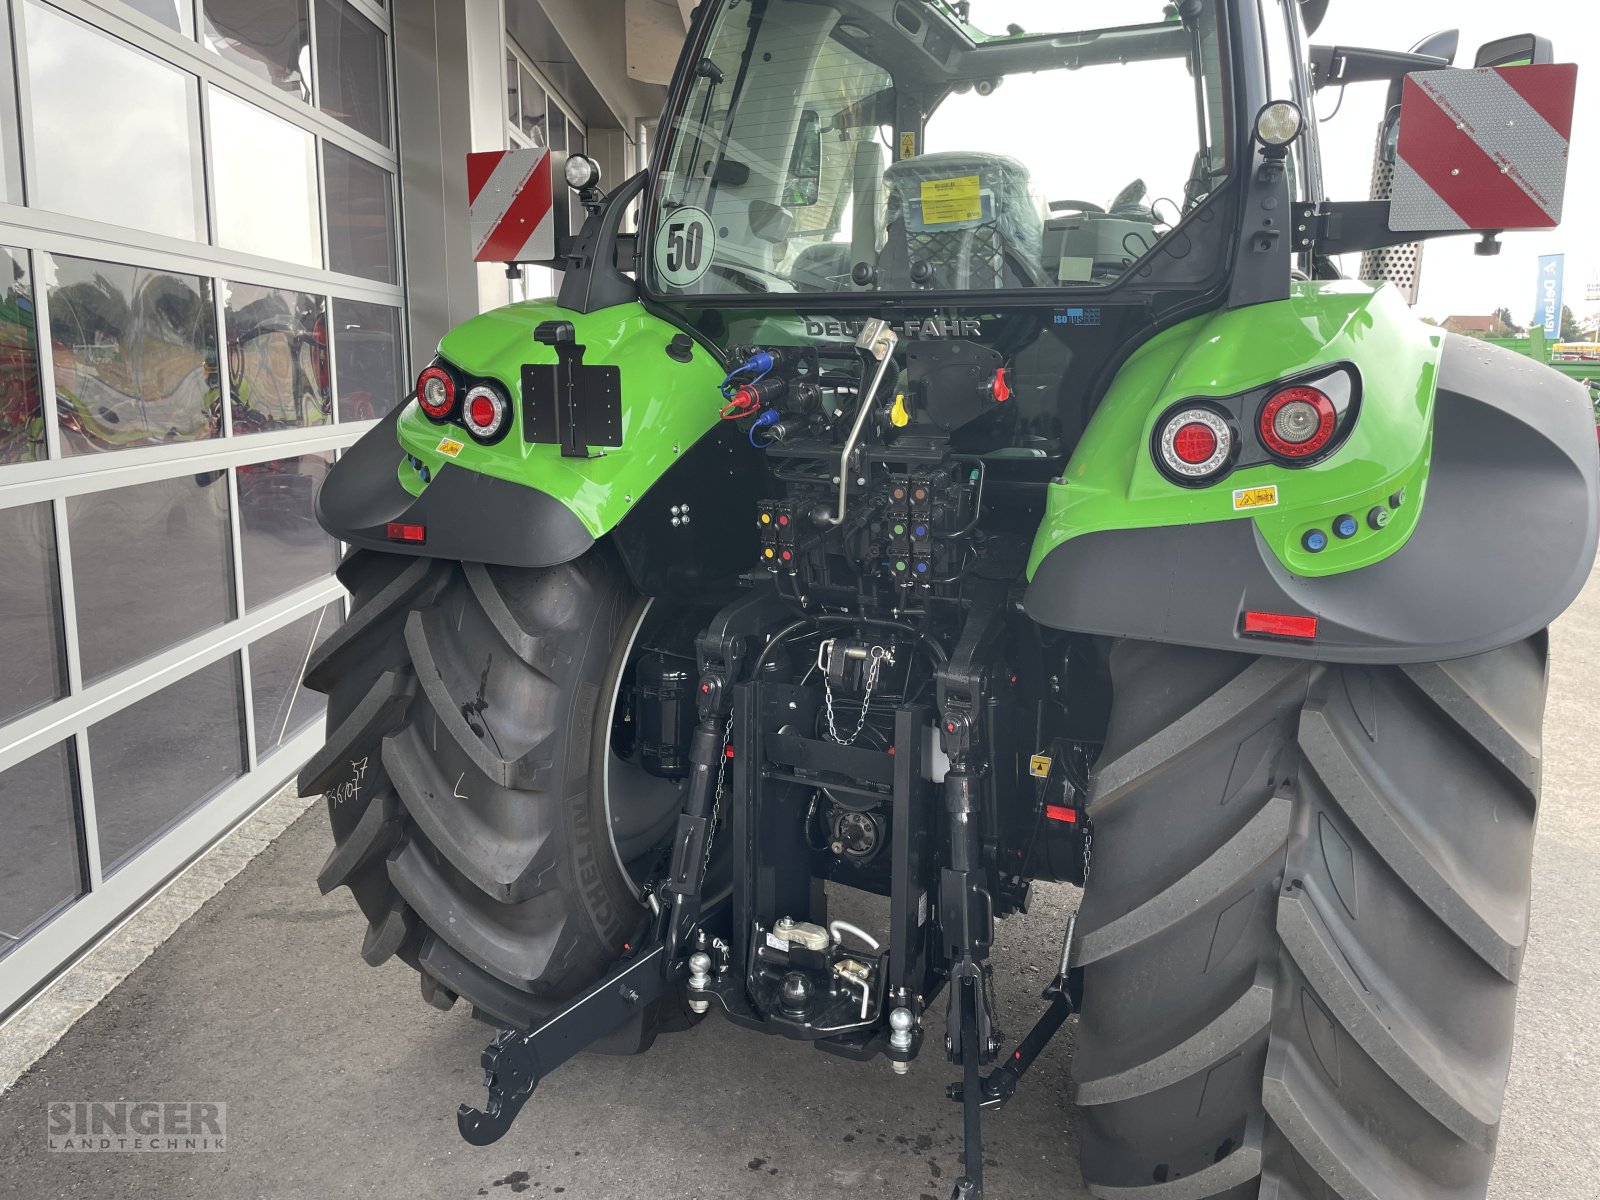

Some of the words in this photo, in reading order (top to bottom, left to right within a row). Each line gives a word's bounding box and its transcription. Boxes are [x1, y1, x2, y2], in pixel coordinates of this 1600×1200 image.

[666, 221, 704, 272] 50
[806, 320, 982, 337] DEU-FAHR
[573, 802, 623, 943] ICHELIN
